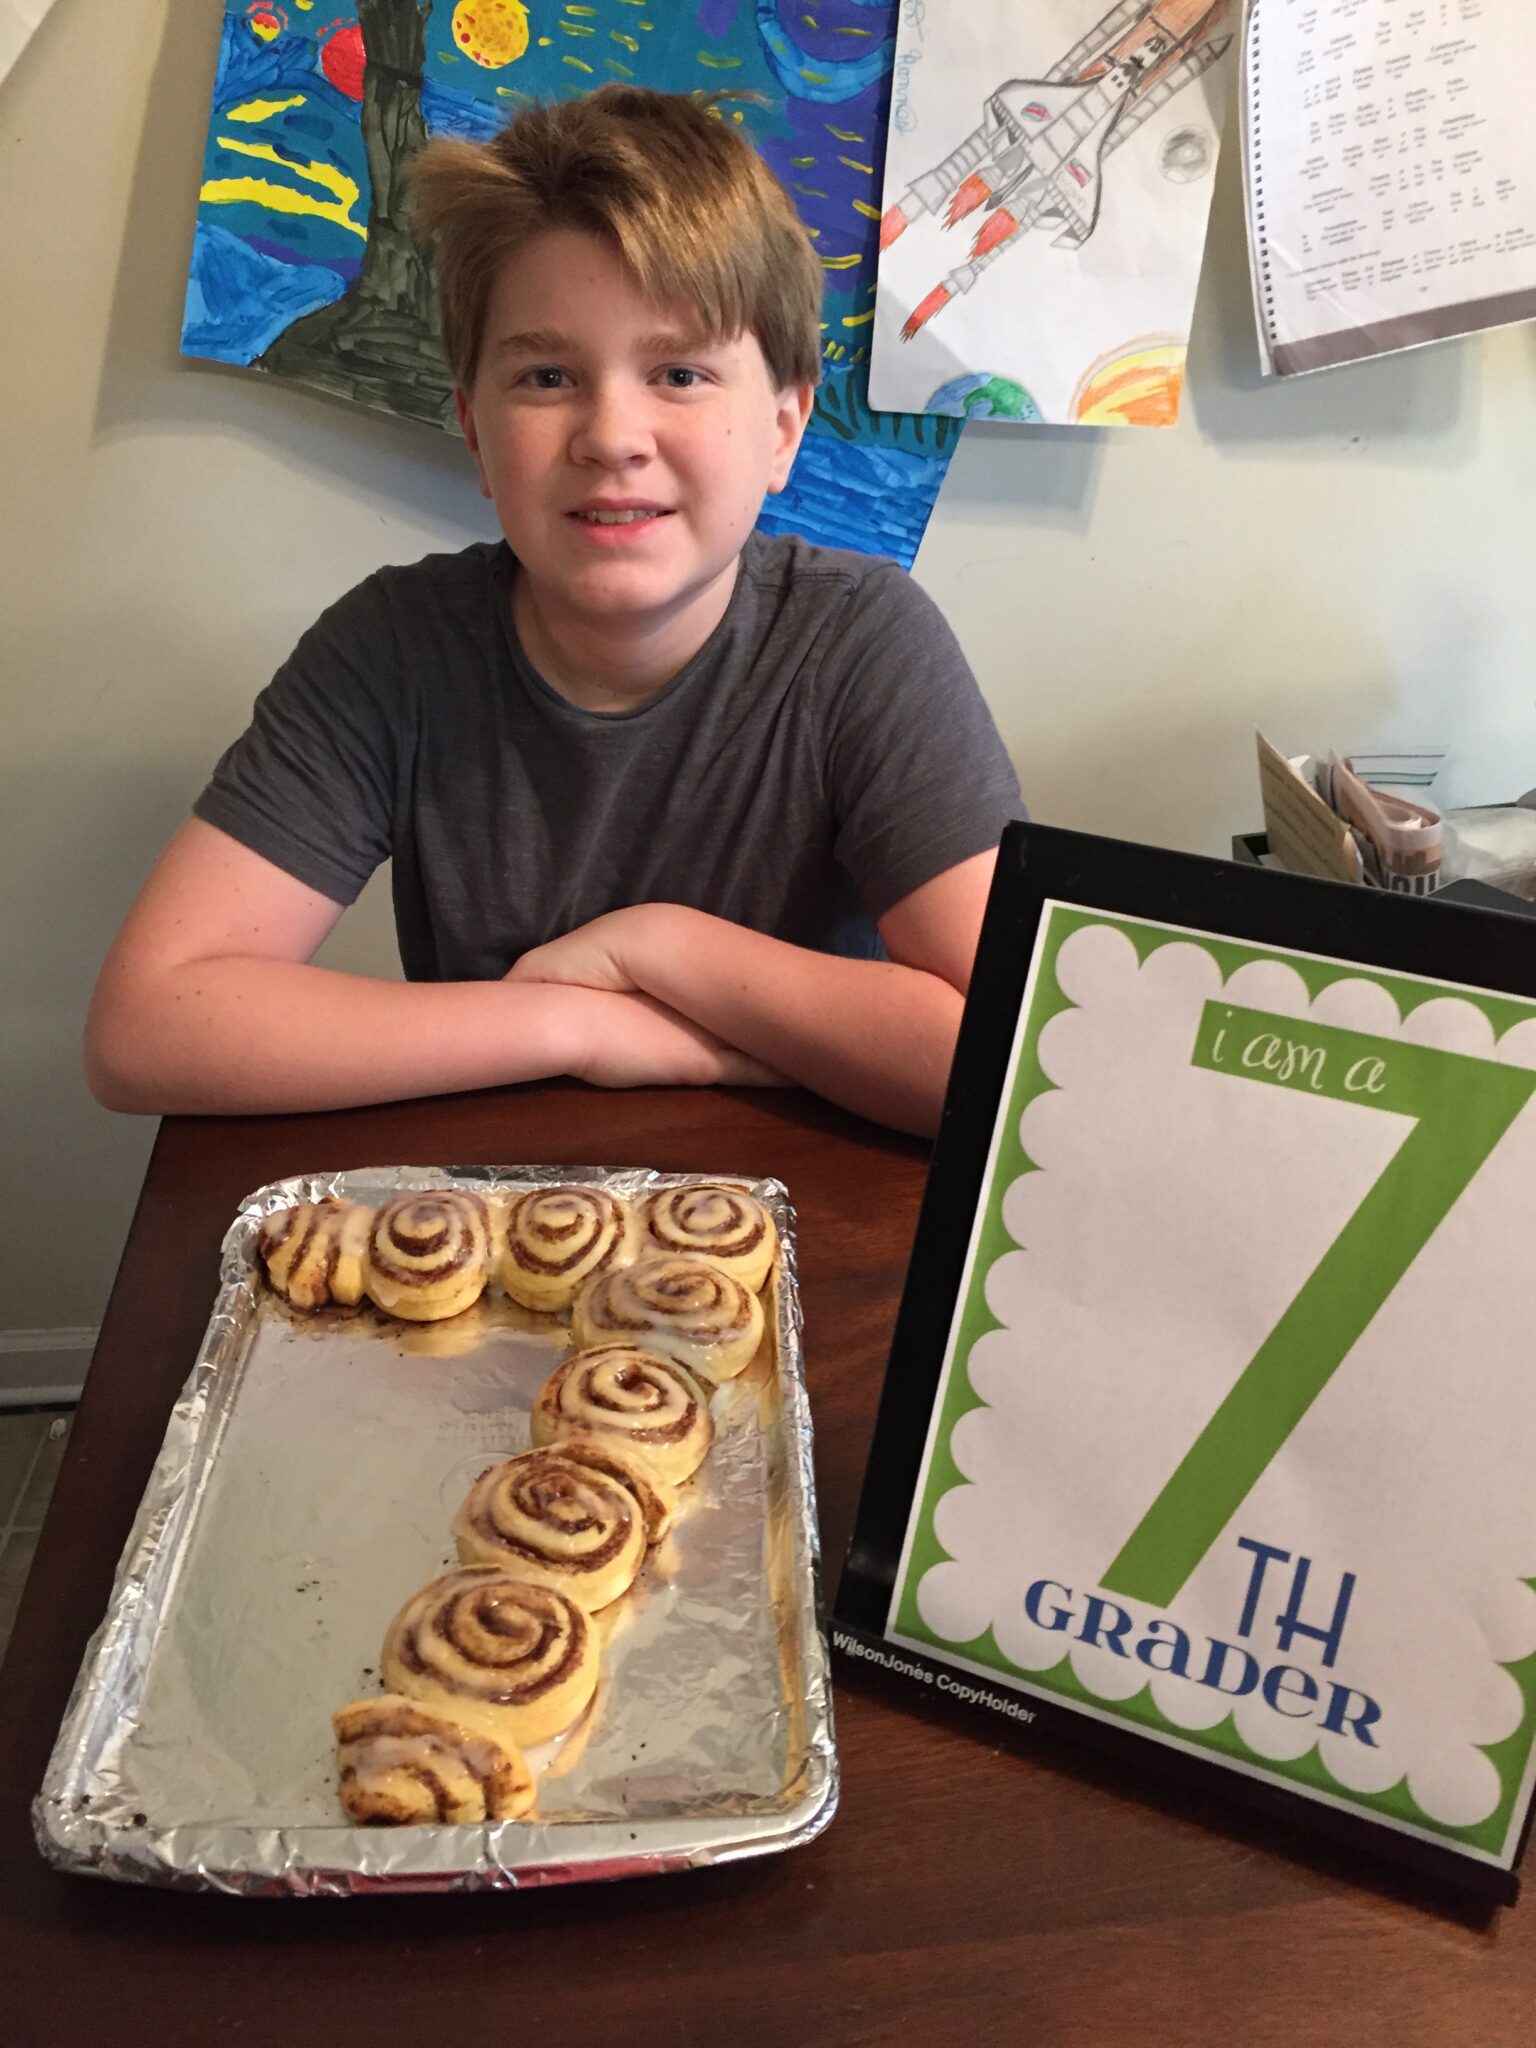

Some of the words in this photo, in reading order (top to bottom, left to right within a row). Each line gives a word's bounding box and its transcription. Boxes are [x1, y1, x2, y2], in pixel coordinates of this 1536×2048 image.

[1212, 1010, 1233, 1063] i
[1241, 1033, 1327, 1090] am
[1344, 1056, 1387, 1094] a
[1098, 999, 1536, 1609] 7
[1237, 1536, 1356, 1668] TH
[937, 1675, 1037, 1724] CopyHolder
